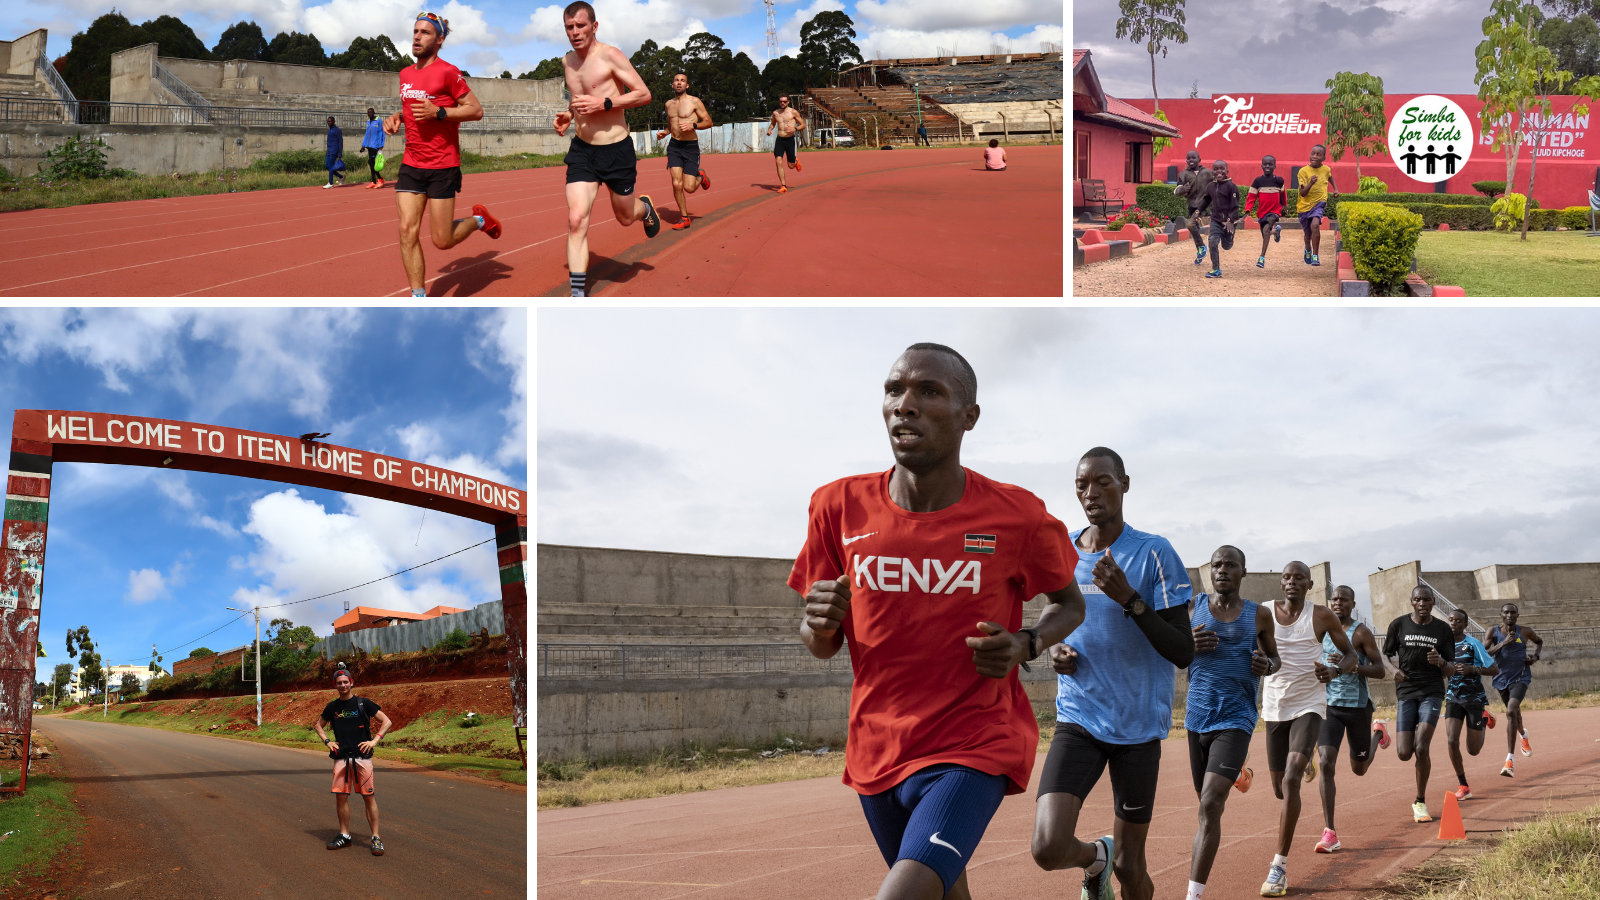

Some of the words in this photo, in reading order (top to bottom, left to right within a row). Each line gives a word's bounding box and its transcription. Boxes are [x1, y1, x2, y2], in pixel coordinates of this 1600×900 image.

[1479, 130, 1494, 145] IS
[1552, 149, 1585, 157] KIPCHOGE
[47, 414, 182, 448] WELCOME
[192, 428, 225, 453] TO
[238, 434, 290, 463] ITEN
[301, 443, 363, 475] HOME
[374, 458, 402, 481] OF
[411, 466, 520, 511] CHAMPIONS
[854, 554, 982, 595] KENYA
[1404, 634, 1438, 644] RUNNING
